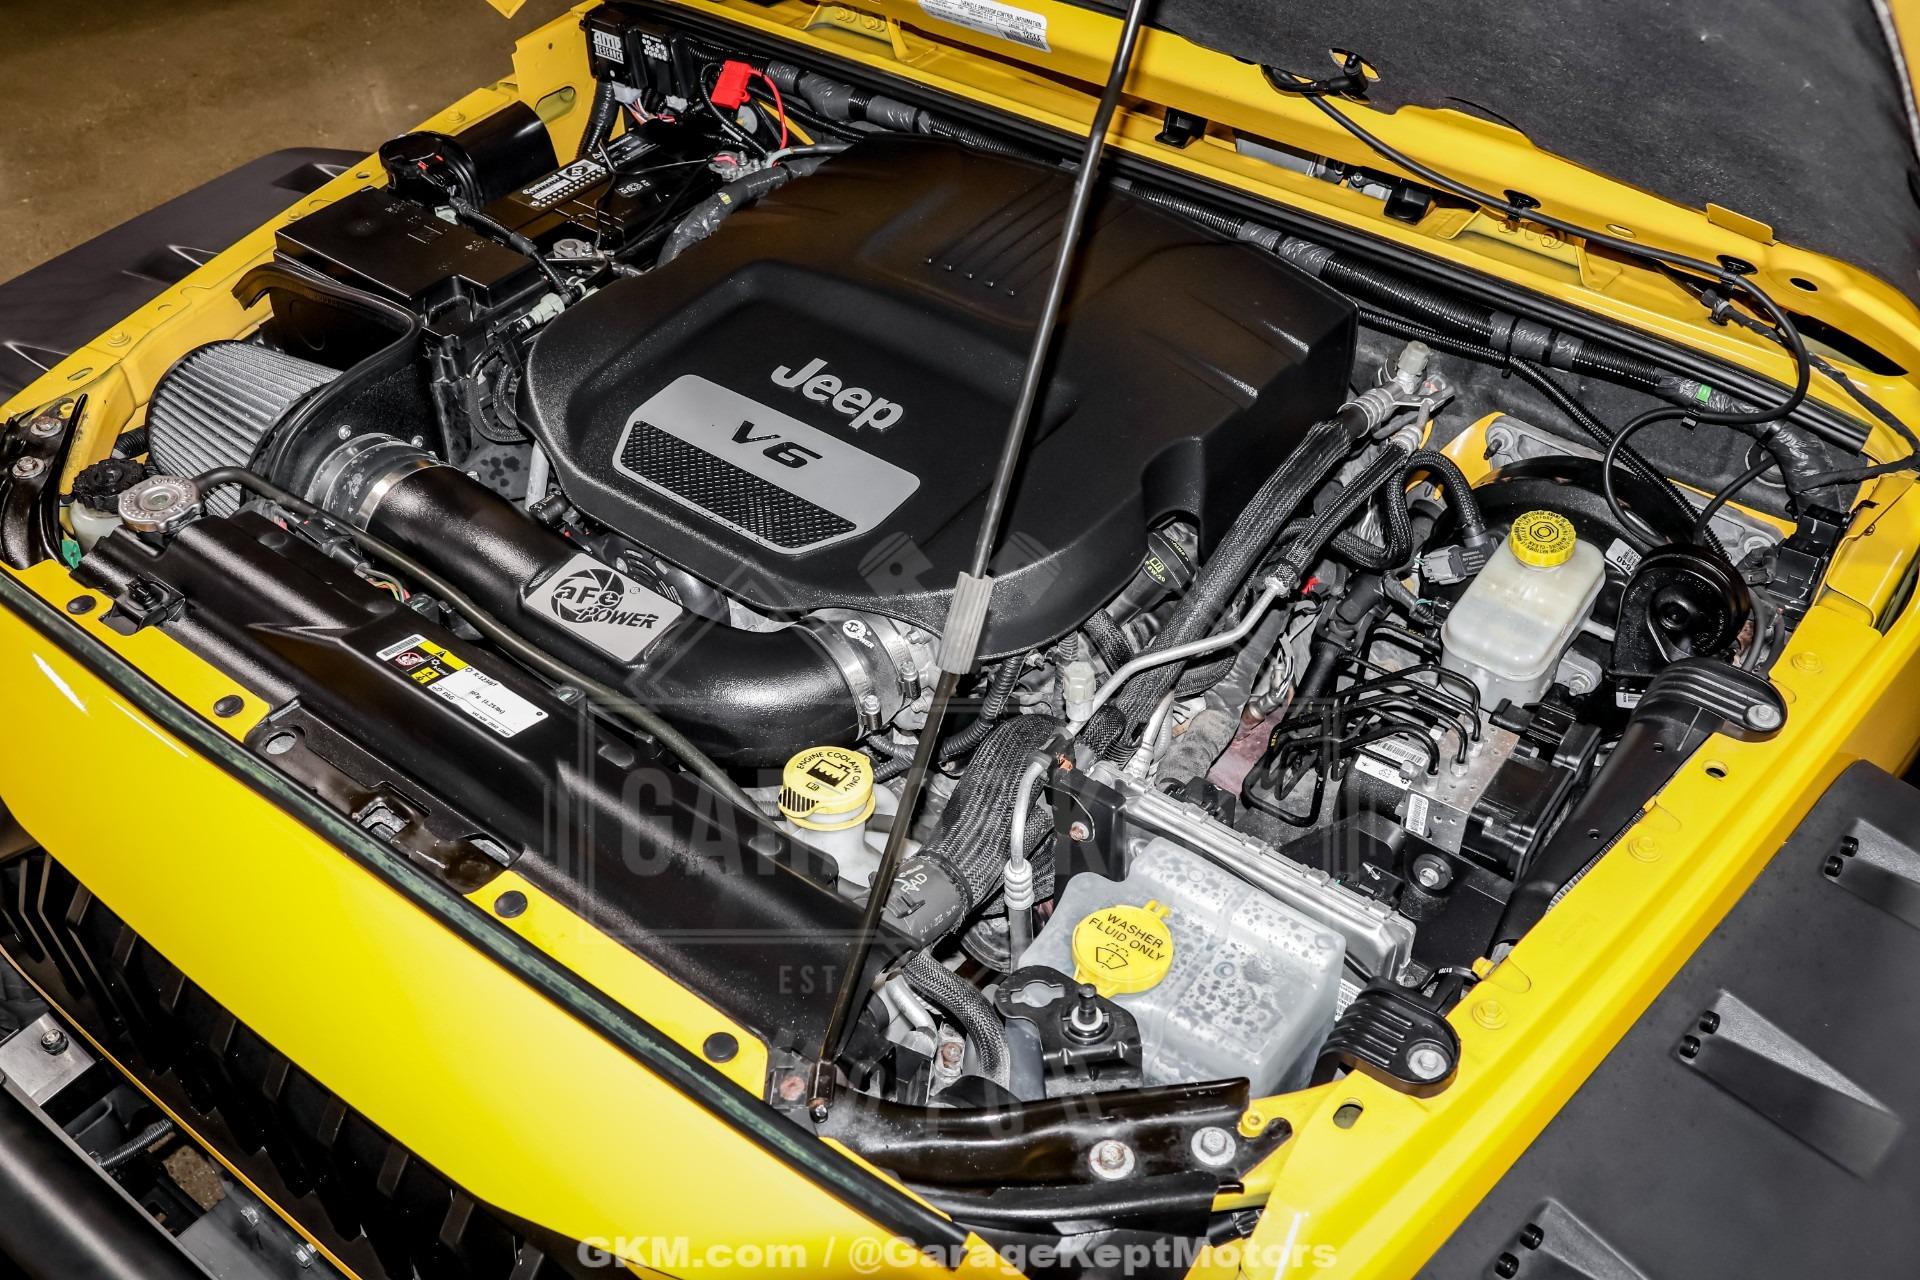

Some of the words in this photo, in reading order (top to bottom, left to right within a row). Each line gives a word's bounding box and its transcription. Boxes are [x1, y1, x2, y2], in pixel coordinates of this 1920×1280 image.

[770, 357, 904, 431] Jeep
[732, 420, 823, 469] V6
[553, 585, 621, 607] aFe
[577, 606, 660, 629] POWER
[796, 751, 824, 770] ENGINE
[826, 751, 863, 774] COOLANT
[843, 775, 861, 792] ONLY
[900, 872, 928, 895] RAD
[1088, 917, 1127, 942] FLUID
[1129, 939, 1166, 962] ONLY
[1107, 913, 1164, 949] WASHER
